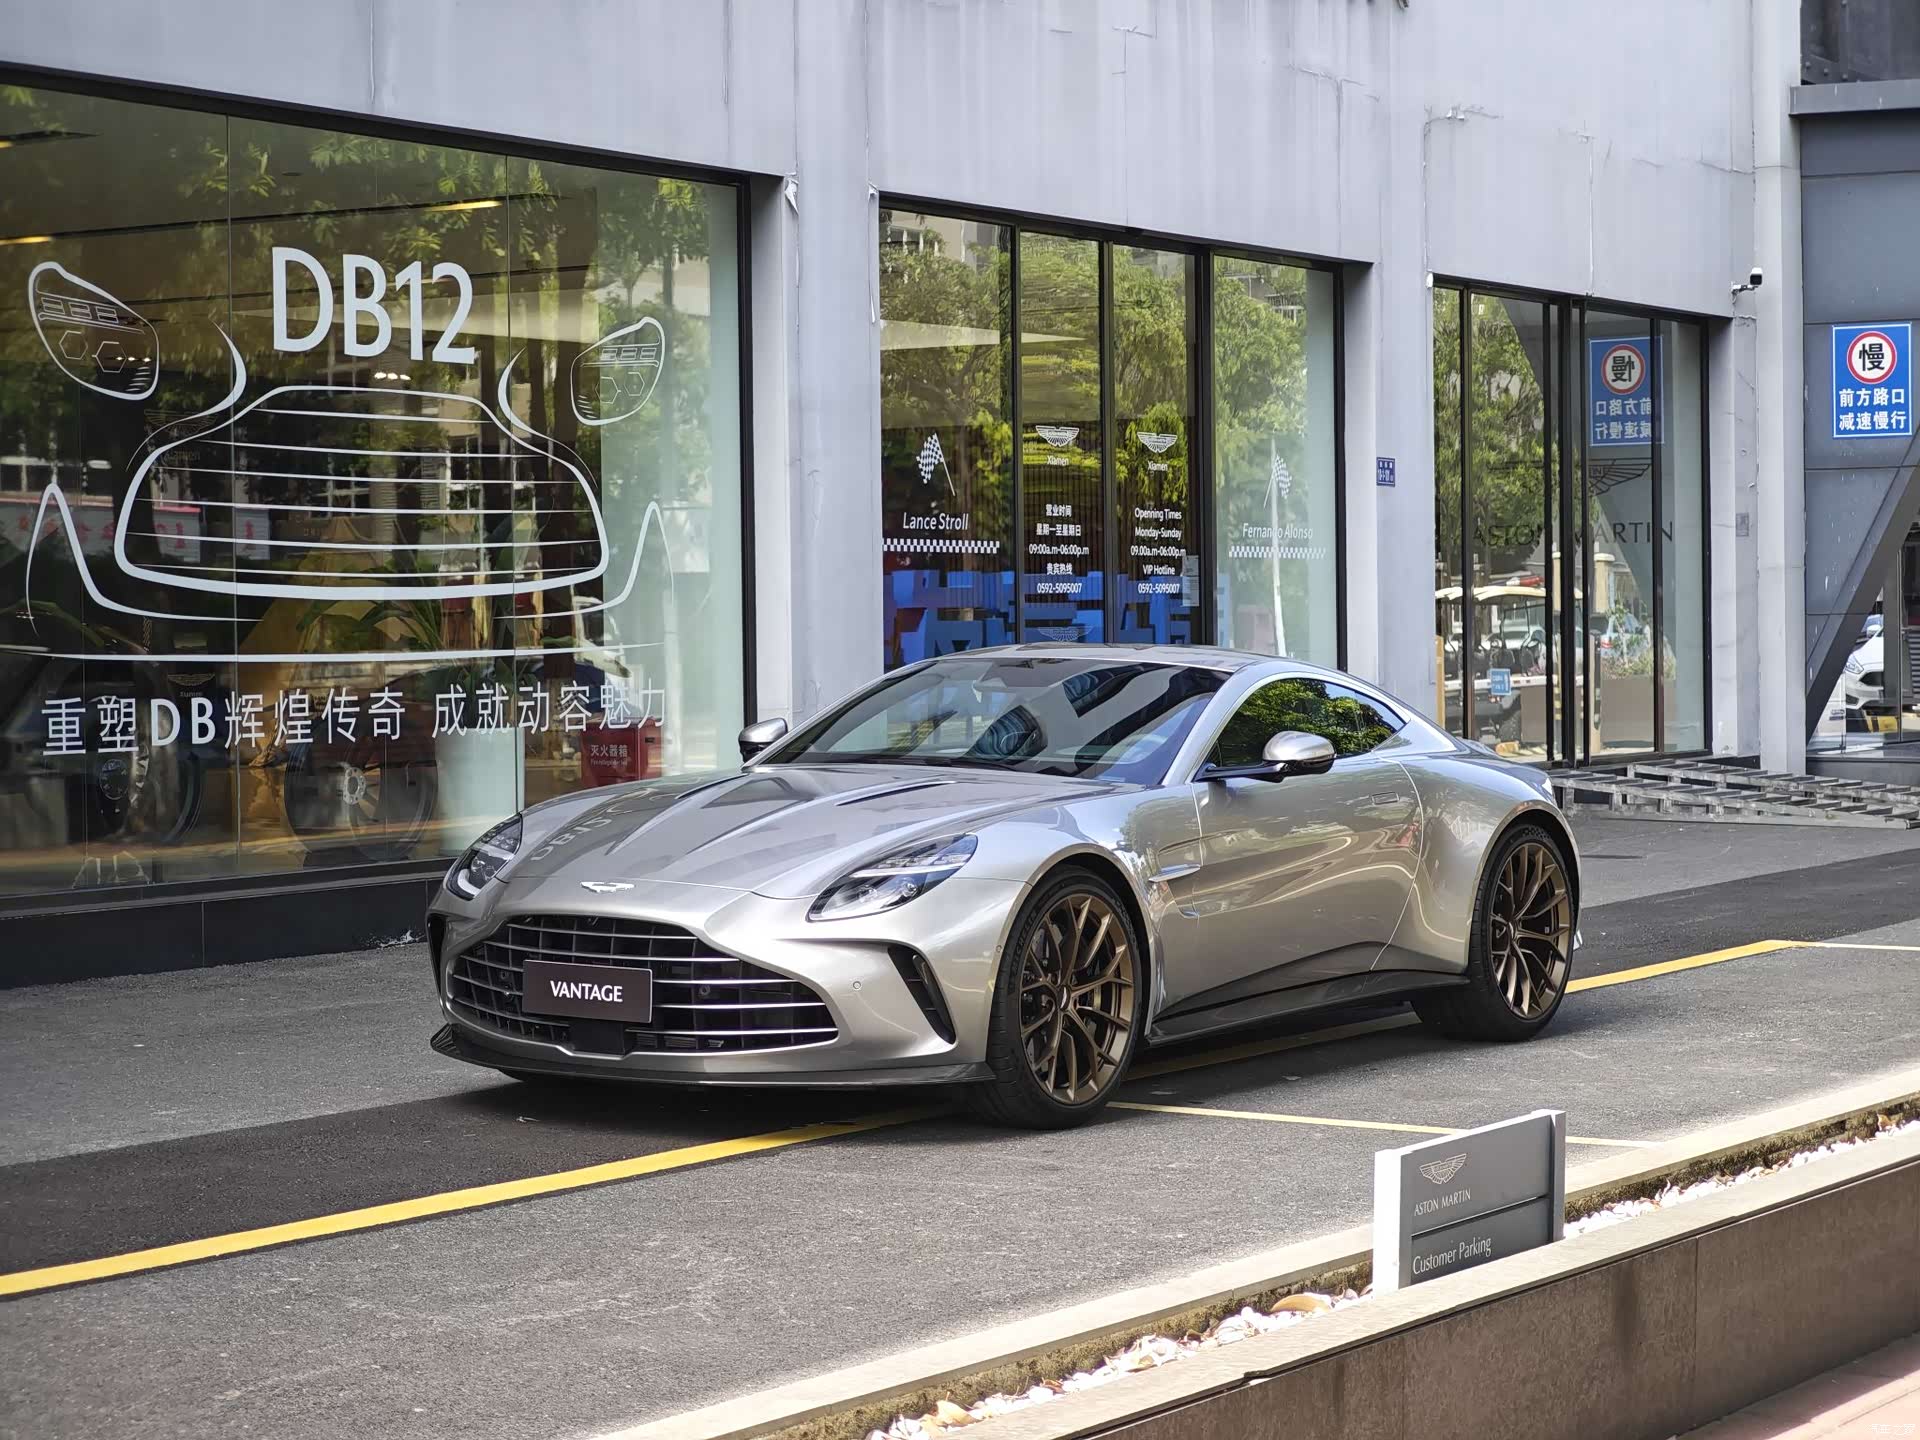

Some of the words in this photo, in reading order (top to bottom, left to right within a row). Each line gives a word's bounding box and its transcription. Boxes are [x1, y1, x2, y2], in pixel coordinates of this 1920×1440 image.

[272, 247, 475, 364] DB12
[1859, 343, 1884, 371] 慢
[1839, 387, 1905, 407] 前方路口
[1839, 410, 1906, 430] 减速慢行
[1047, 455, 1069, 466] Xiamen
[1148, 460, 1168, 471] Xiamen
[1045, 504, 1072, 517] 营业时间
[1164, 508, 1182, 520] Times
[902, 512, 937, 530] Lance
[938, 512, 969, 530] Stroll
[1036, 522, 1082, 536] 星期一至星期日
[1135, 526, 1182, 541] Monday-Sunday
[1284, 523, 1313, 540] Alonso
[1046, 562, 1073, 575] 贵宾热线
[1143, 564, 1154, 575] VIP
[1153, 564, 1176, 575] Hotline
[1037, 582, 1082, 594] 0592-5095007
[1138, 583, 1180, 594] 0592-5095007
[41, 686, 406, 756] 重塑DB辉煌传奇
[432, 678, 665, 739] 成就动容魅力
[590, 744, 628, 758] 灭火器箱
[550, 980, 623, 1003] VANTAGE
[1414, 1197, 1439, 1217] ASTON
[1441, 1188, 1471, 1208] MARTIN
[1413, 1248, 1457, 1275] Customer
[1459, 1237, 1492, 1260] Parking
